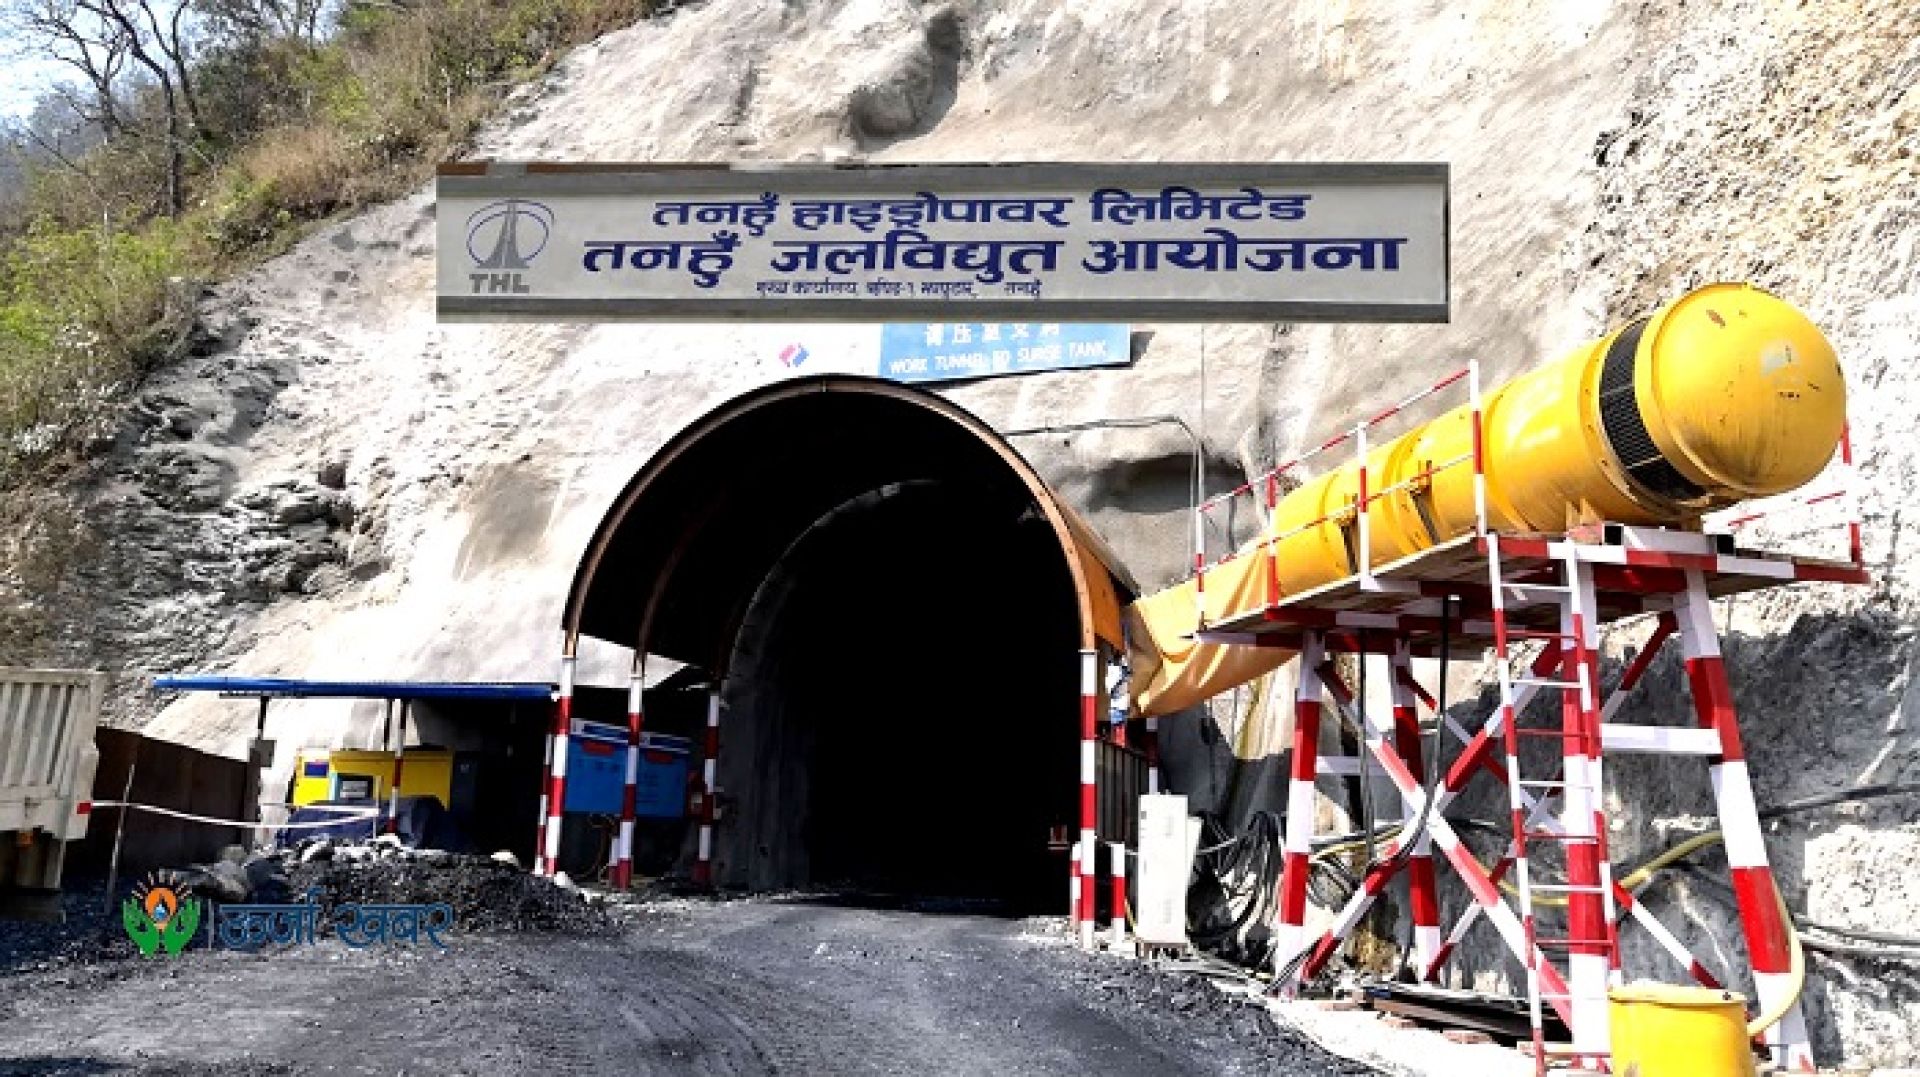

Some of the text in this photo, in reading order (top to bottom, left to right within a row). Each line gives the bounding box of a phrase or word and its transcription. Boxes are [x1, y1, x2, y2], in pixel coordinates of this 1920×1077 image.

[652, 185, 1312, 236] तनहुँ हाइड्रोपावर लिमिटेड
[582, 227, 1408, 289] तनहुँ जलविद्युत आयोजना
[468, 273, 530, 295] THL
[890, 357, 928, 374] WORK
[1068, 340, 1107, 359] TANK
